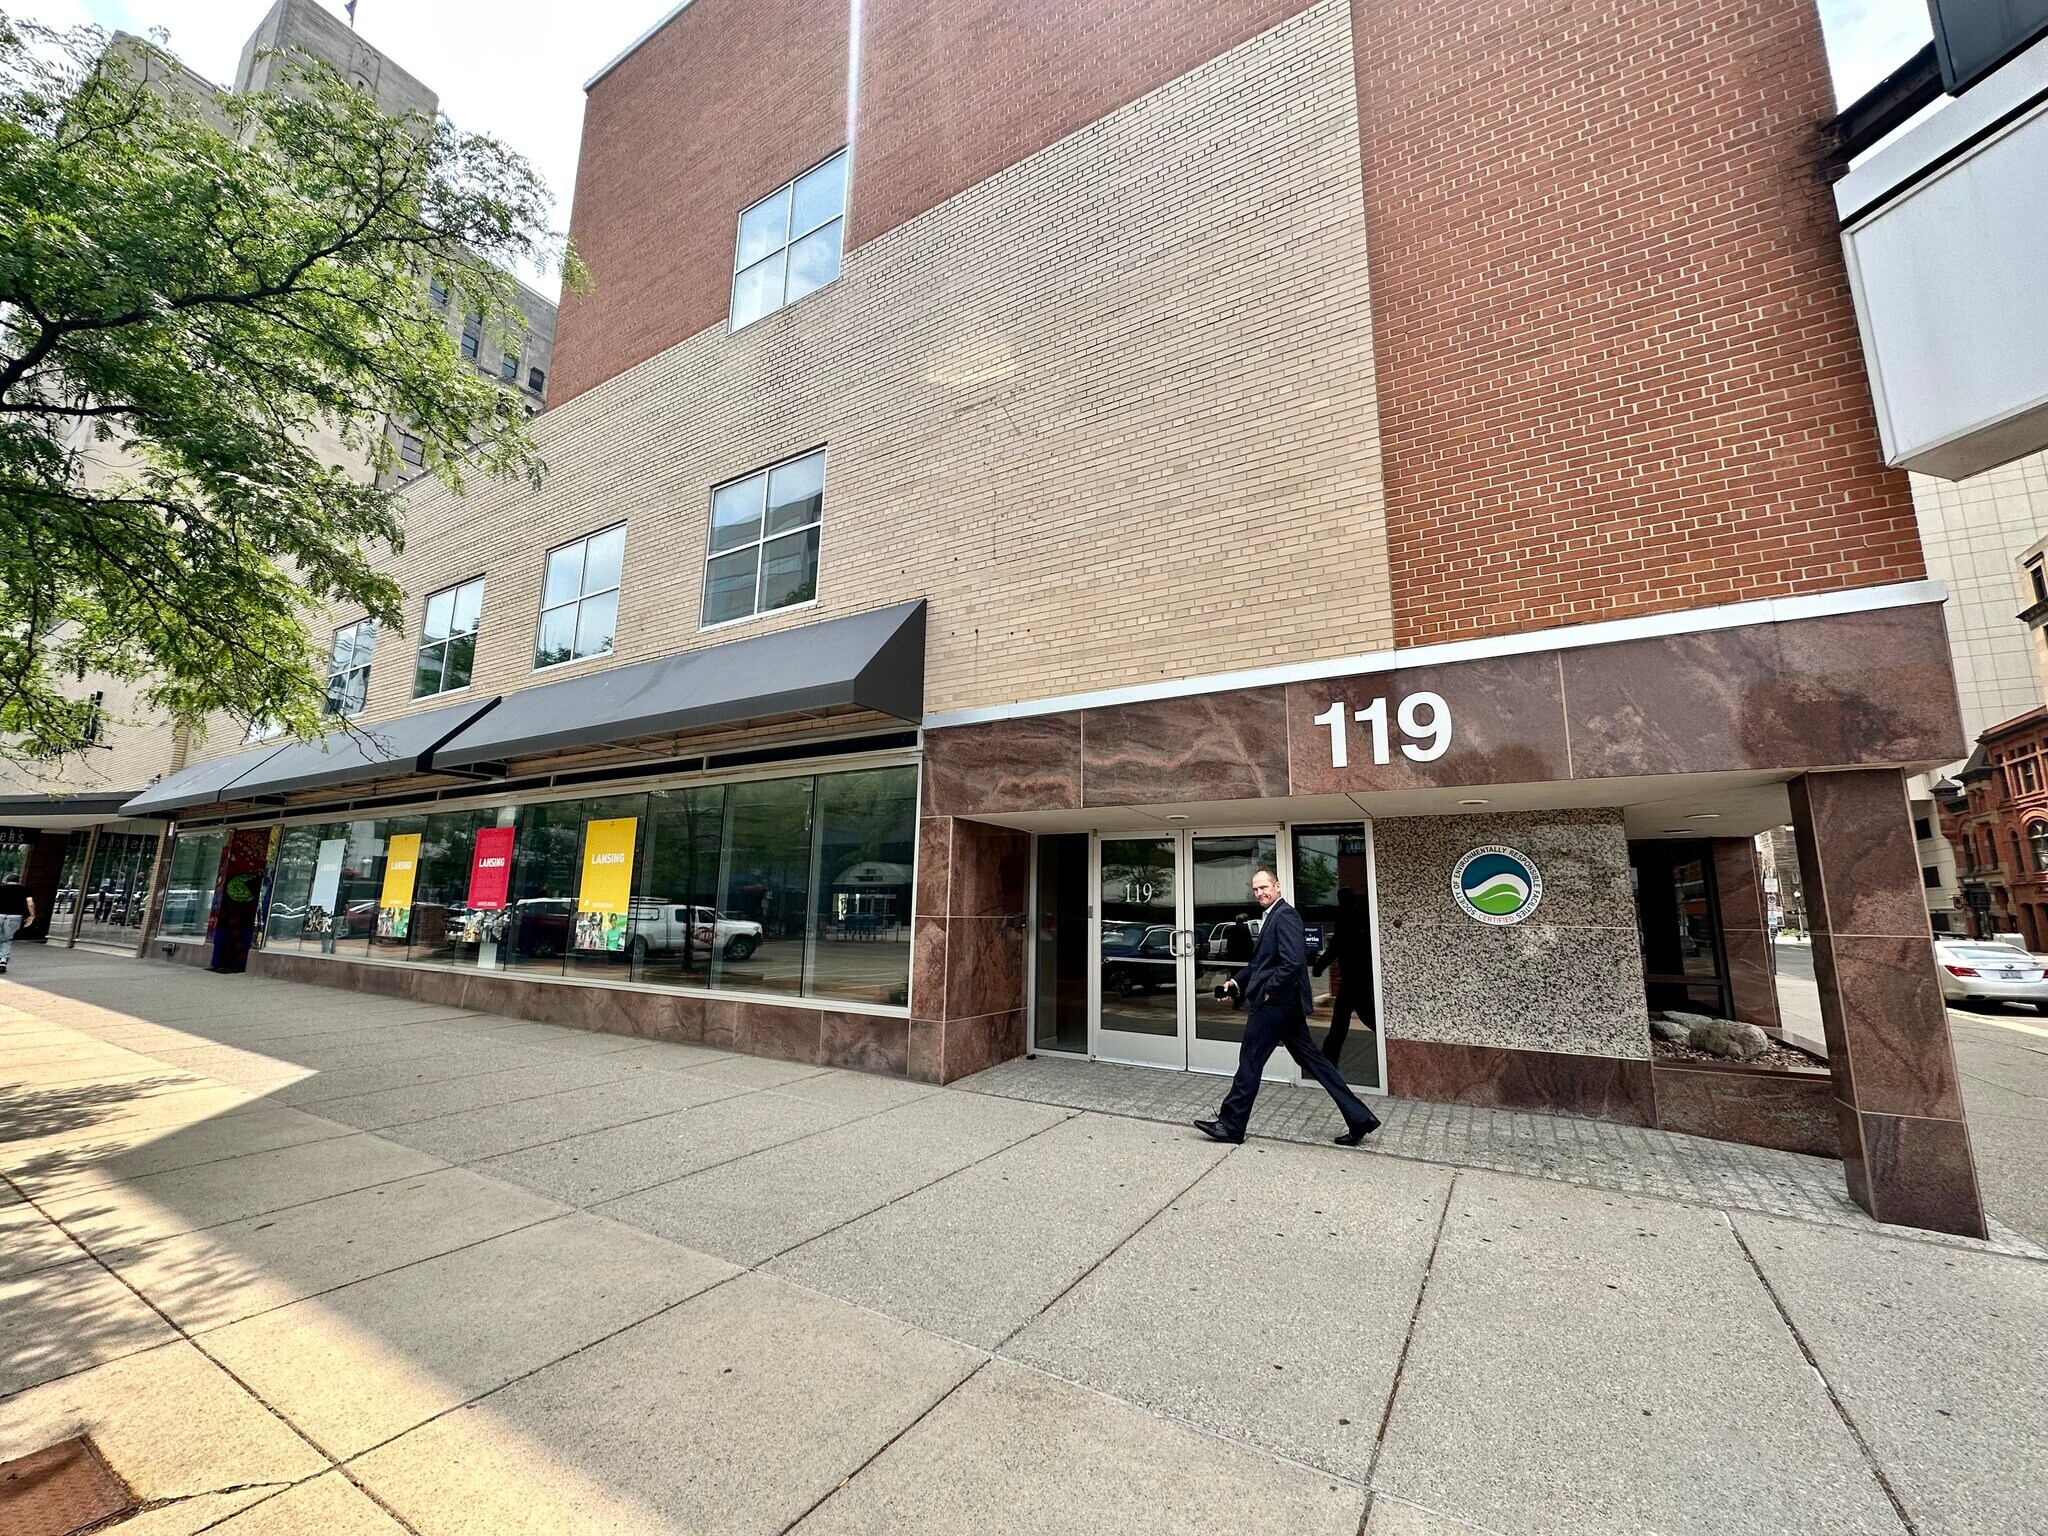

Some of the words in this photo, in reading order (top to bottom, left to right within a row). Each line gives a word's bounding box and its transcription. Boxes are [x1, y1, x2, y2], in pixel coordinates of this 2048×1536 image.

[1314, 691, 1452, 768] 119
[479, 858, 505, 867] LANSING
[592, 853, 625, 864] LANSING
[1454, 846, 1507, 879] ENVIRONMENTALLY
[1509, 850, 1540, 888] RESPONSIBLE
[1125, 882, 1153, 903] 119
[1453, 881, 1460, 890] OF
[1455, 892, 1477, 916] SOCIETY
[1516, 891, 1540, 918] FACILITIES
[1479, 914, 1514, 922] CERTIFIED
